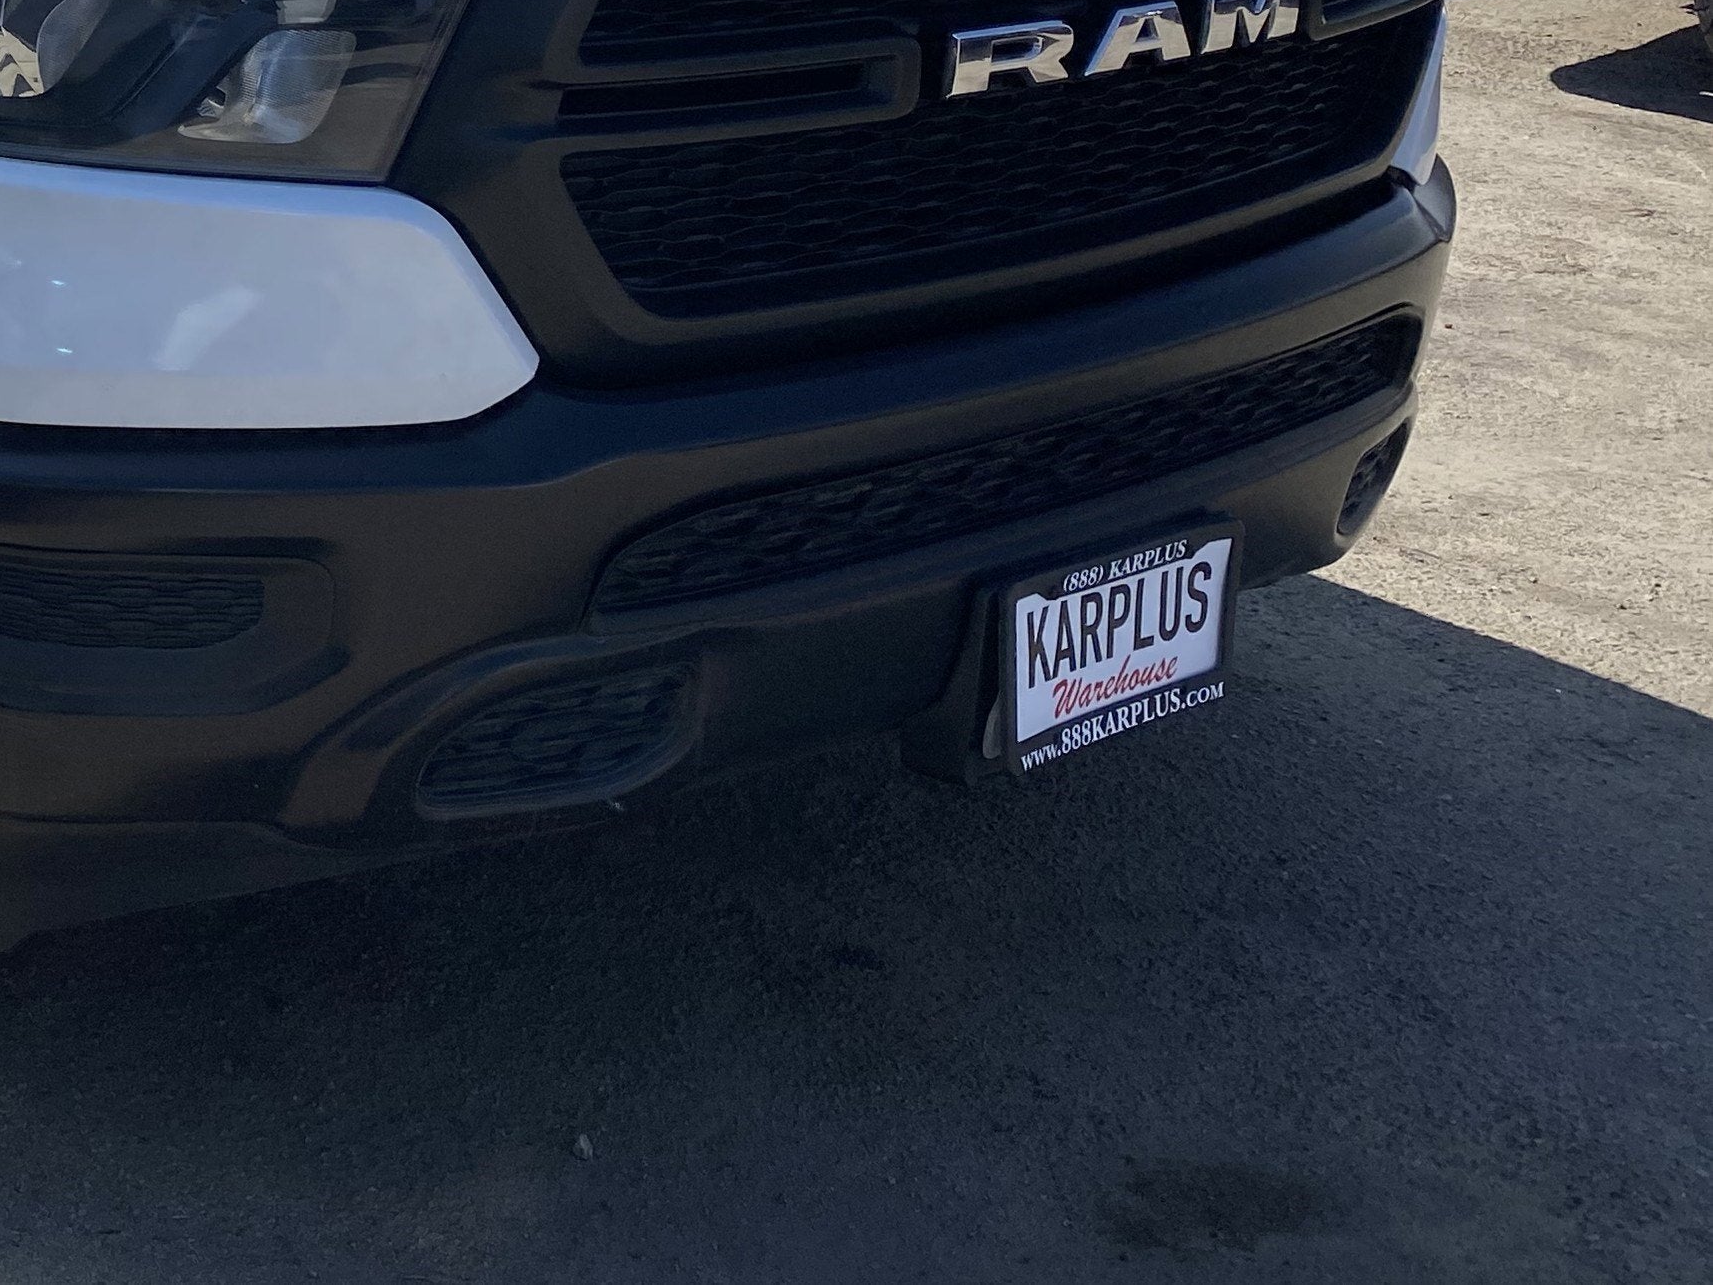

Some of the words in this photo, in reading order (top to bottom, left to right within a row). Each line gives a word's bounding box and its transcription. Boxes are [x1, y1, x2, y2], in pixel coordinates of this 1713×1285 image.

[1063, 565, 1104, 592] (888)
[1108, 539, 1187, 581] KARPLUS
[1026, 561, 1212, 689] KARPLUS
[1052, 655, 1179, 719] Warehouse
